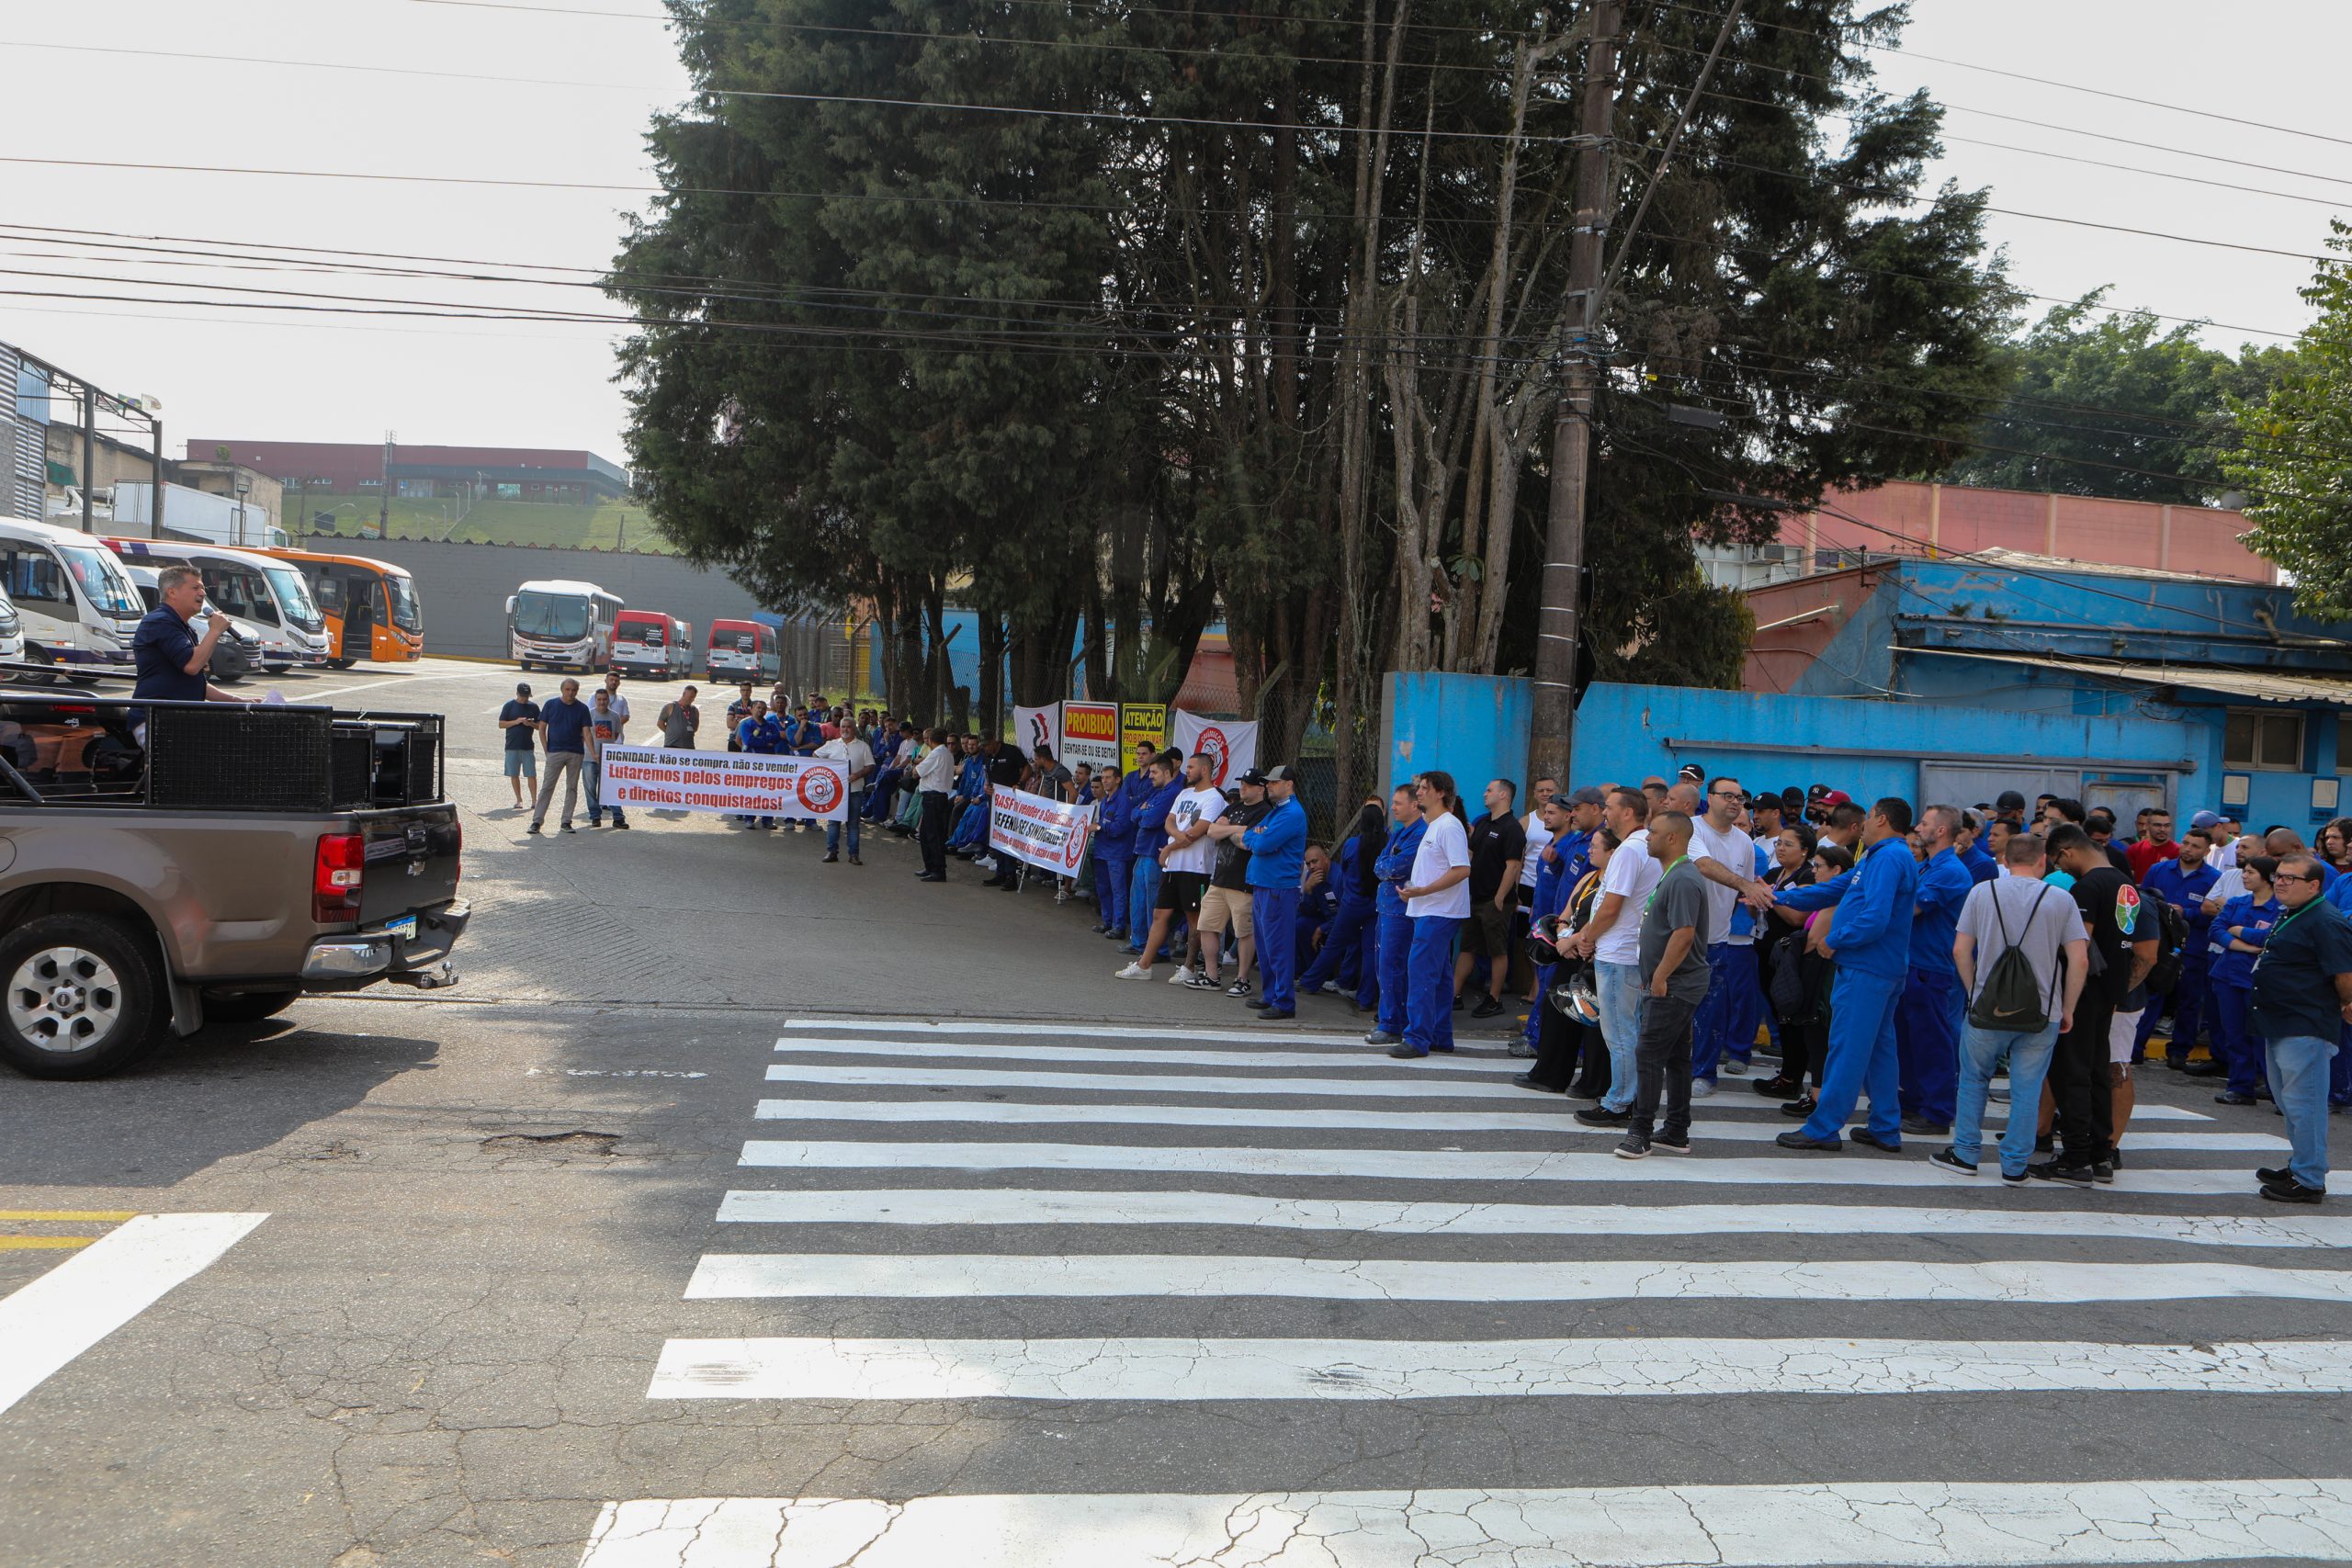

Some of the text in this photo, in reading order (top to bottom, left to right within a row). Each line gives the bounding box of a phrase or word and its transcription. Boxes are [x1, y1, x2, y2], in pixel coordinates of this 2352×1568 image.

[1066, 712, 1114, 736] PROIBIDO
[1125, 709, 1162, 730] ATENÇÃO
[1124, 732, 1162, 745] PROIBIDO FUMAR
[1064, 742, 1087, 757] SENTAR-SE
[1088, 745, 1094, 757] OU
[1095, 746, 1101, 758] SE
[1102, 747, 1116, 760] DEITAR
[606, 750, 798, 774] DIGNIDADE: Não se compra, não se vende!
[608, 763, 793, 791] Lutaremos pelos empregos
[805, 767, 835, 781] QUÍMICOS
[617, 786, 783, 810] e direitos conquistados!
[995, 794, 1014, 812] BASF
[1178, 800, 1198, 814] NBA
